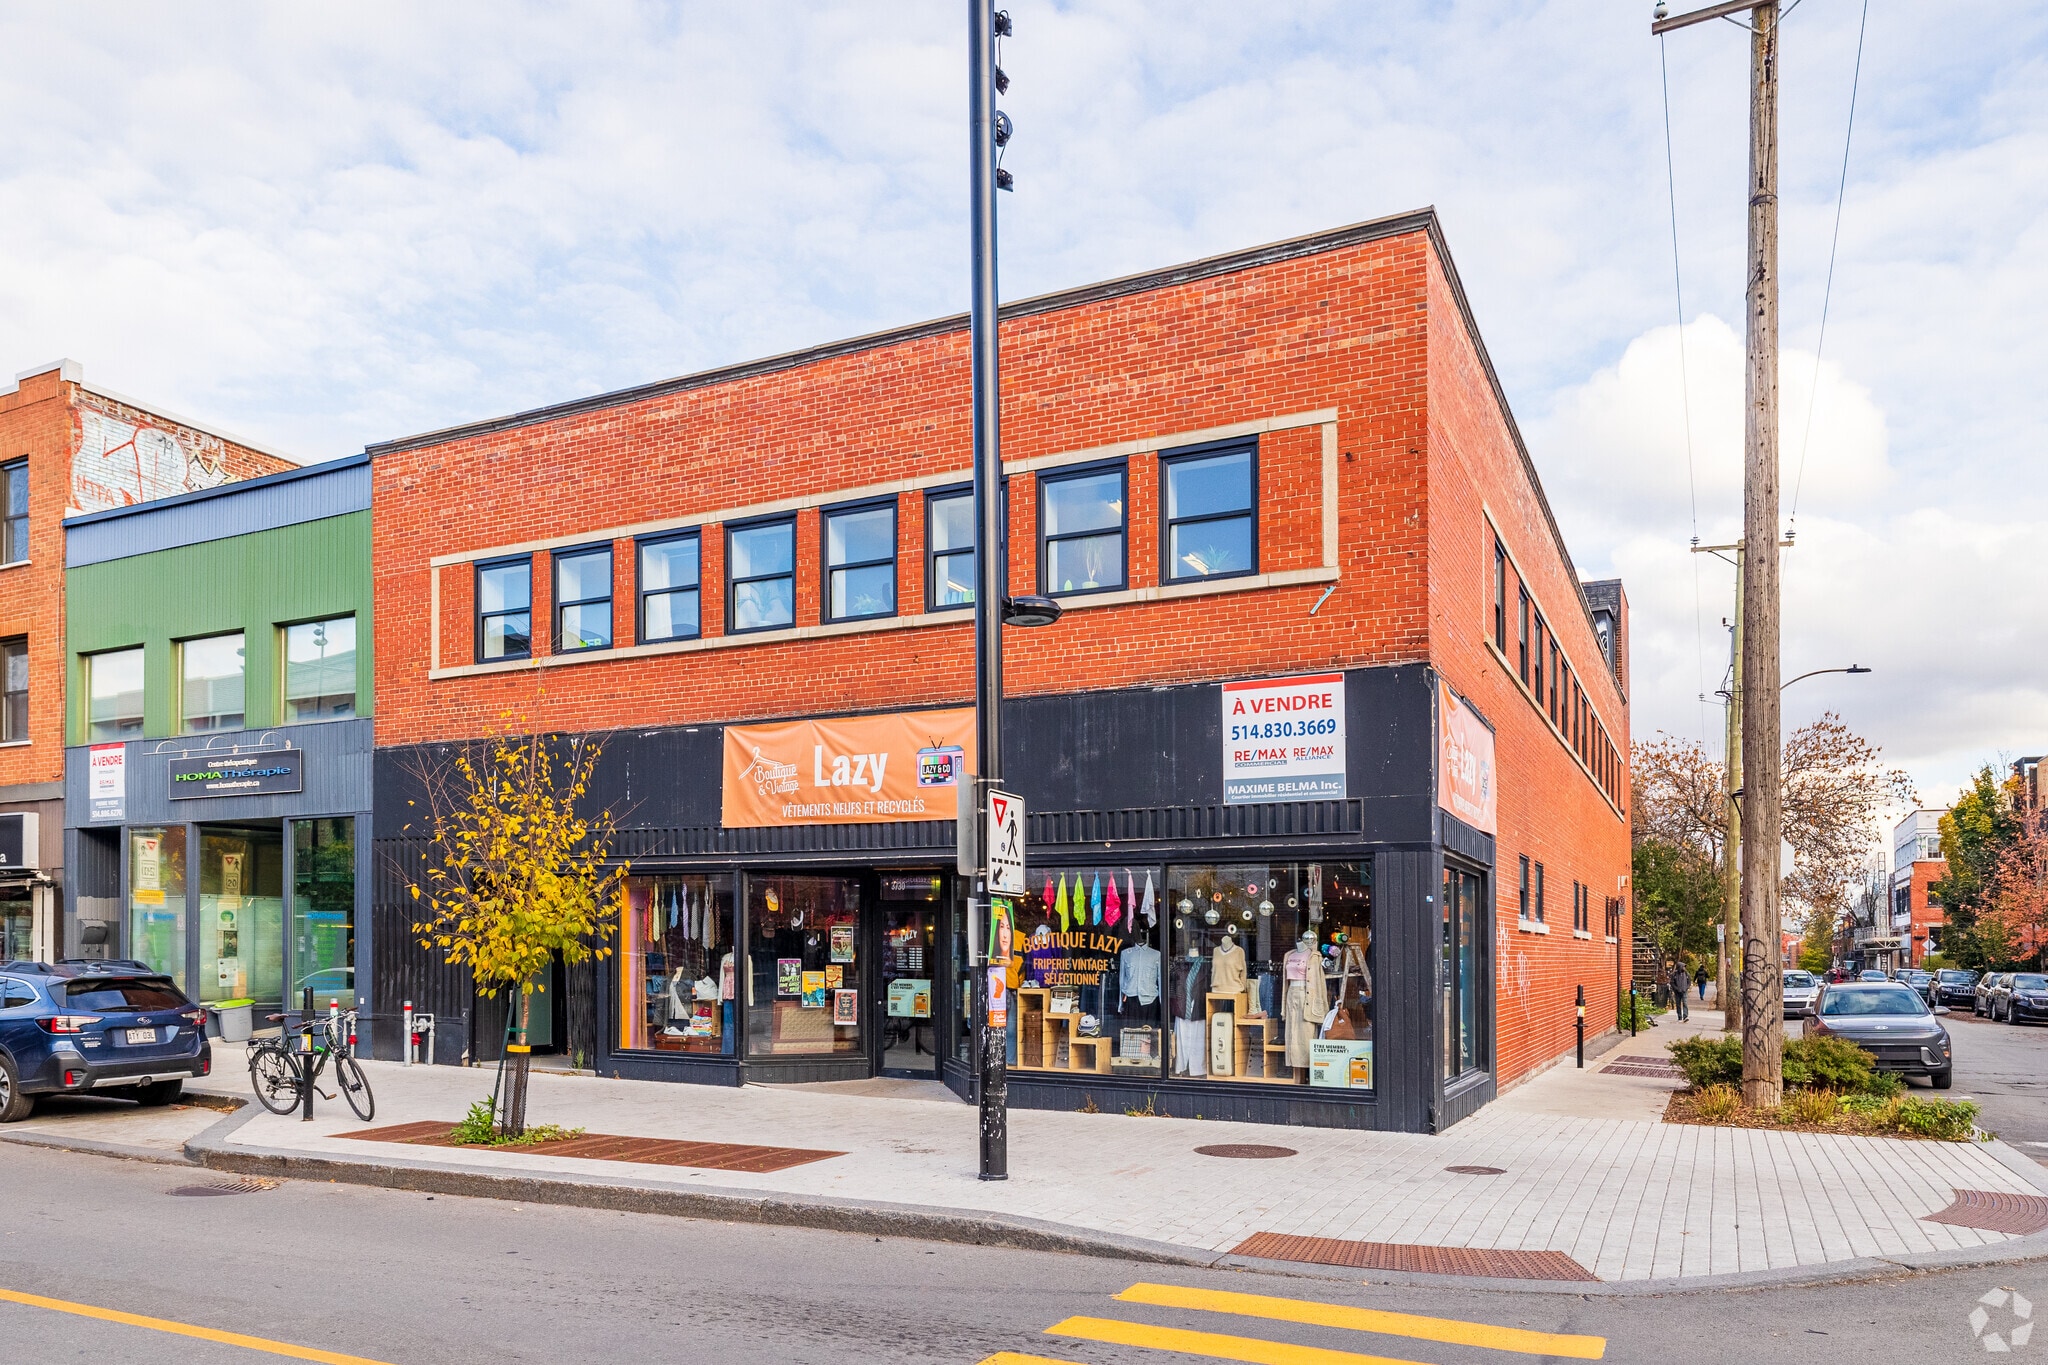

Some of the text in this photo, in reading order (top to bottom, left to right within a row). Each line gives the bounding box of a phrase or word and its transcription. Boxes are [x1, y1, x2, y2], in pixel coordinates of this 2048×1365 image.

[1232, 693, 1333, 715] À VENDRE
[1231, 718, 1336, 741] 514.830.3669
[1234, 748, 1287, 762] RE/MAX
[1293, 745, 1334, 757] RE/MAX
[97, 754, 123, 767] VENDRE
[1235, 760, 1286, 768] COMMERCIAL
[175, 766, 291, 781] HOMAThérapie
[754, 764, 798, 783] Boutique
[814, 745, 888, 793] Lazy
[922, 763, 951, 775] LAZY & CO
[758, 779, 800, 796] & Vintage
[1228, 780, 1342, 795] MAXIME BELMA Inc.
[782, 796, 925, 818] VÊTEMENTS NEUFS ET RECYCLÉS
[891, 881, 906, 890] 3730
[1023, 931, 1123, 955] BOUTIQUE LAZY
[1033, 958, 1108, 972] FRIPERIE VINTAGE
[1044, 971, 1100, 986] SÉLECTIONNÉ
